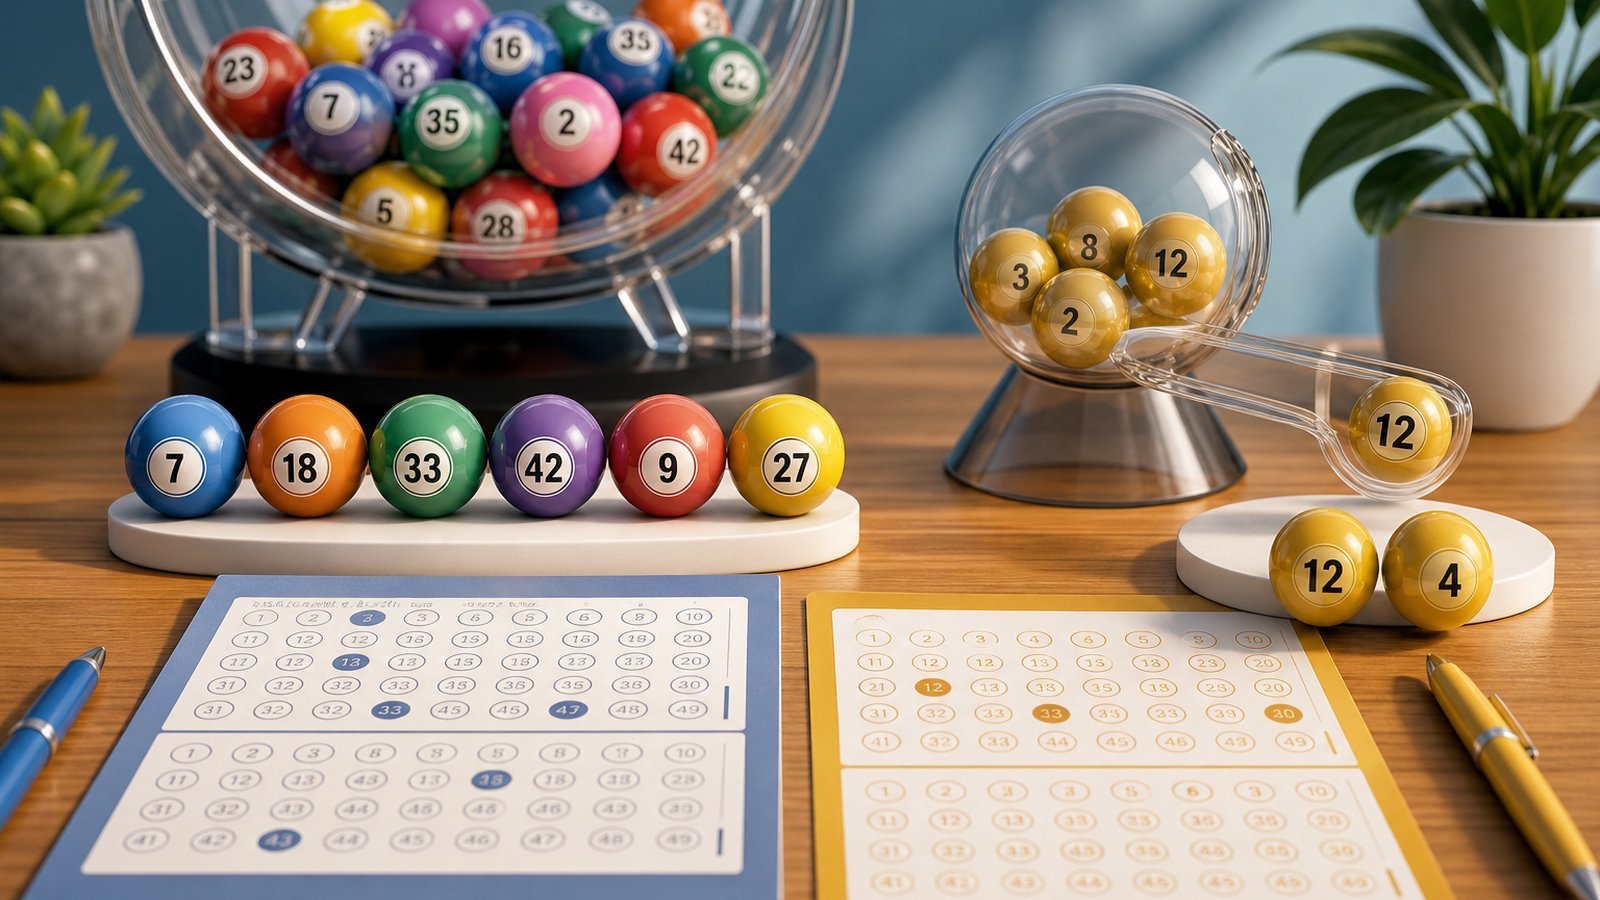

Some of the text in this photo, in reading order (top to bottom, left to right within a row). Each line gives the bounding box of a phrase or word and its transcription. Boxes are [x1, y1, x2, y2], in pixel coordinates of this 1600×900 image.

[494, 36, 522, 60] 16
[619, 28, 651, 52] 35
[222, 56, 254, 85] 23
[322, 93, 340, 120] 7
[425, 108, 460, 135] 35
[558, 108, 576, 136] 2
[668, 138, 700, 166] 42
[376, 198, 393, 226] 5
[481, 214, 515, 239] 28
[1080, 233, 1098, 261] 8
[1012, 262, 1030, 291] 3
[1154, 248, 1188, 278] 12
[1060, 306, 1079, 336] 2
[1376, 413, 1416, 450] 12
[164, 453, 185, 484] 7
[282, 453, 318, 484] 18
[403, 453, 442, 484] 33
[524, 453, 563, 484] 42
[658, 453, 678, 484] 9
[772, 453, 811, 484] 27
[1303, 558, 1343, 594] 12
[1437, 562, 1462, 598] 4
[258, 614, 264, 622] 1
[308, 613, 320, 622] 2
[416, 613, 427, 622] 3
[578, 613, 590, 622] 6
[686, 612, 704, 621] 10
[243, 635, 258, 644] 11
[296, 635, 314, 644] 12
[352, 635, 369, 644] 12
[682, 634, 703, 643] 20
[870, 634, 876, 643] 1
[922, 634, 932, 644] 2
[975, 634, 986, 644] 3
[1029, 635, 1040, 644] 4
[1083, 635, 1094, 644] 6
[1138, 635, 1150, 644] 5
[1244, 635, 1264, 644] 10
[285, 657, 304, 667] 12
[680, 656, 702, 666] 20
[868, 658, 882, 666] 11
[921, 658, 939, 667] 12
[975, 658, 994, 667] 12
[1030, 658, 1050, 668] 13
[1197, 658, 1218, 668] 23
[1252, 658, 1274, 668] 20
[215, 681, 236, 690] 31
[330, 680, 353, 690] 32
[387, 681, 410, 690] 33
[678, 680, 701, 690] 30
[868, 682, 885, 692] 21
[924, 682, 943, 692] 12
[1264, 683, 1285, 693] 20
[202, 705, 223, 715] 31
[260, 705, 284, 714] 32
[319, 705, 344, 715] 32
[378, 705, 402, 715] 33
[437, 705, 462, 714] 45
[615, 705, 640, 714] 48
[676, 705, 700, 714] 49
[870, 708, 887, 718] 31
[926, 708, 946, 718] 32
[983, 709, 1005, 718] 33
[1040, 708, 1063, 719] 33
[678, 748, 697, 758] 10
[871, 736, 890, 747] 41
[1046, 737, 1069, 746] 44
[168, 775, 187, 785] 11
[231, 775, 252, 786] 12
[1307, 786, 1328, 797] 10
[149, 804, 172, 816] 31
[940, 814, 961, 826] 12
